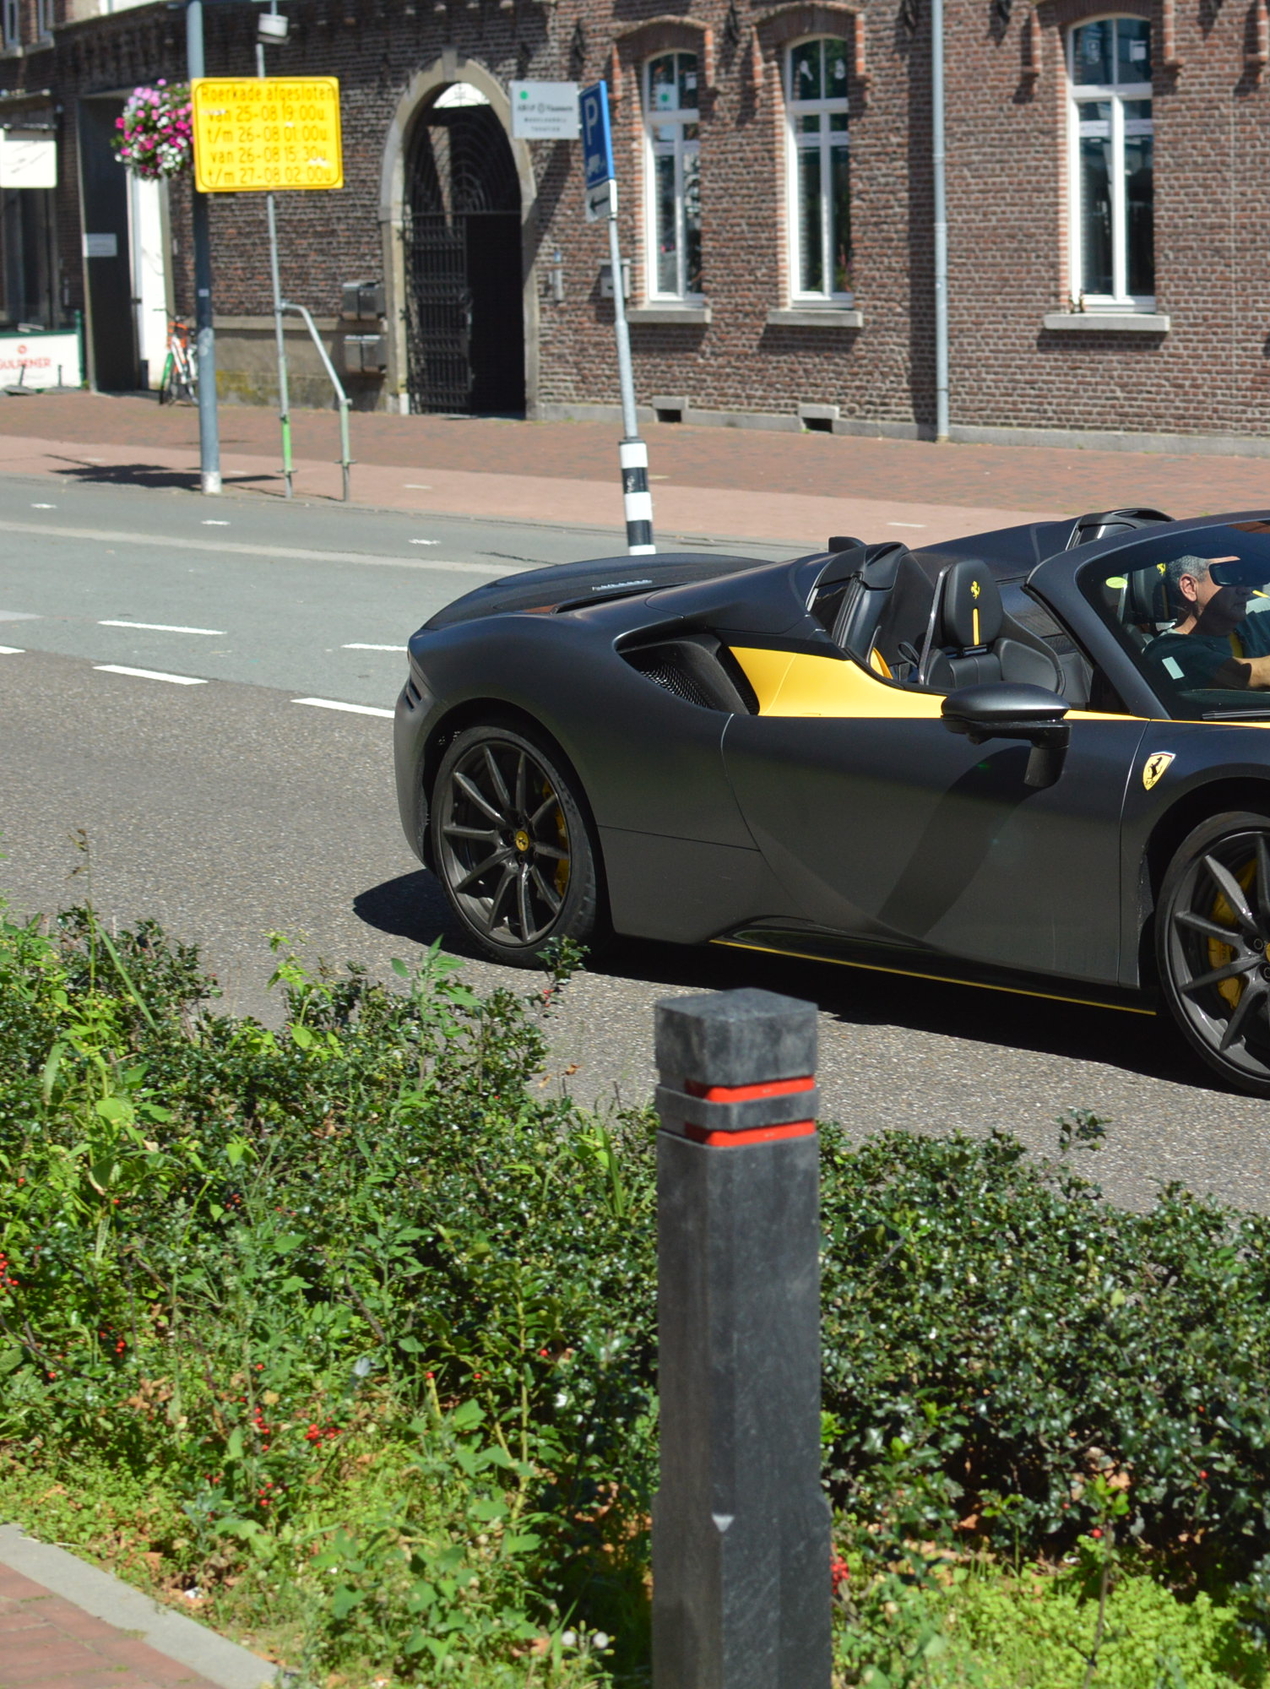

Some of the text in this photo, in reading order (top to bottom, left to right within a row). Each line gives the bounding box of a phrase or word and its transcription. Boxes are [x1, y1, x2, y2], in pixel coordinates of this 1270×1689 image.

[201, 84, 335, 104] Roerkade afgesloten
[207, 109, 232, 122] van
[236, 105, 278, 122] 25-08
[207, 126, 234, 143] t/m
[238, 125, 280, 143] 26-08
[211, 151, 234, 164] van
[238, 146, 281, 163] 26-08
[208, 168, 235, 185] t/m
[239, 167, 281, 184] 27-08
